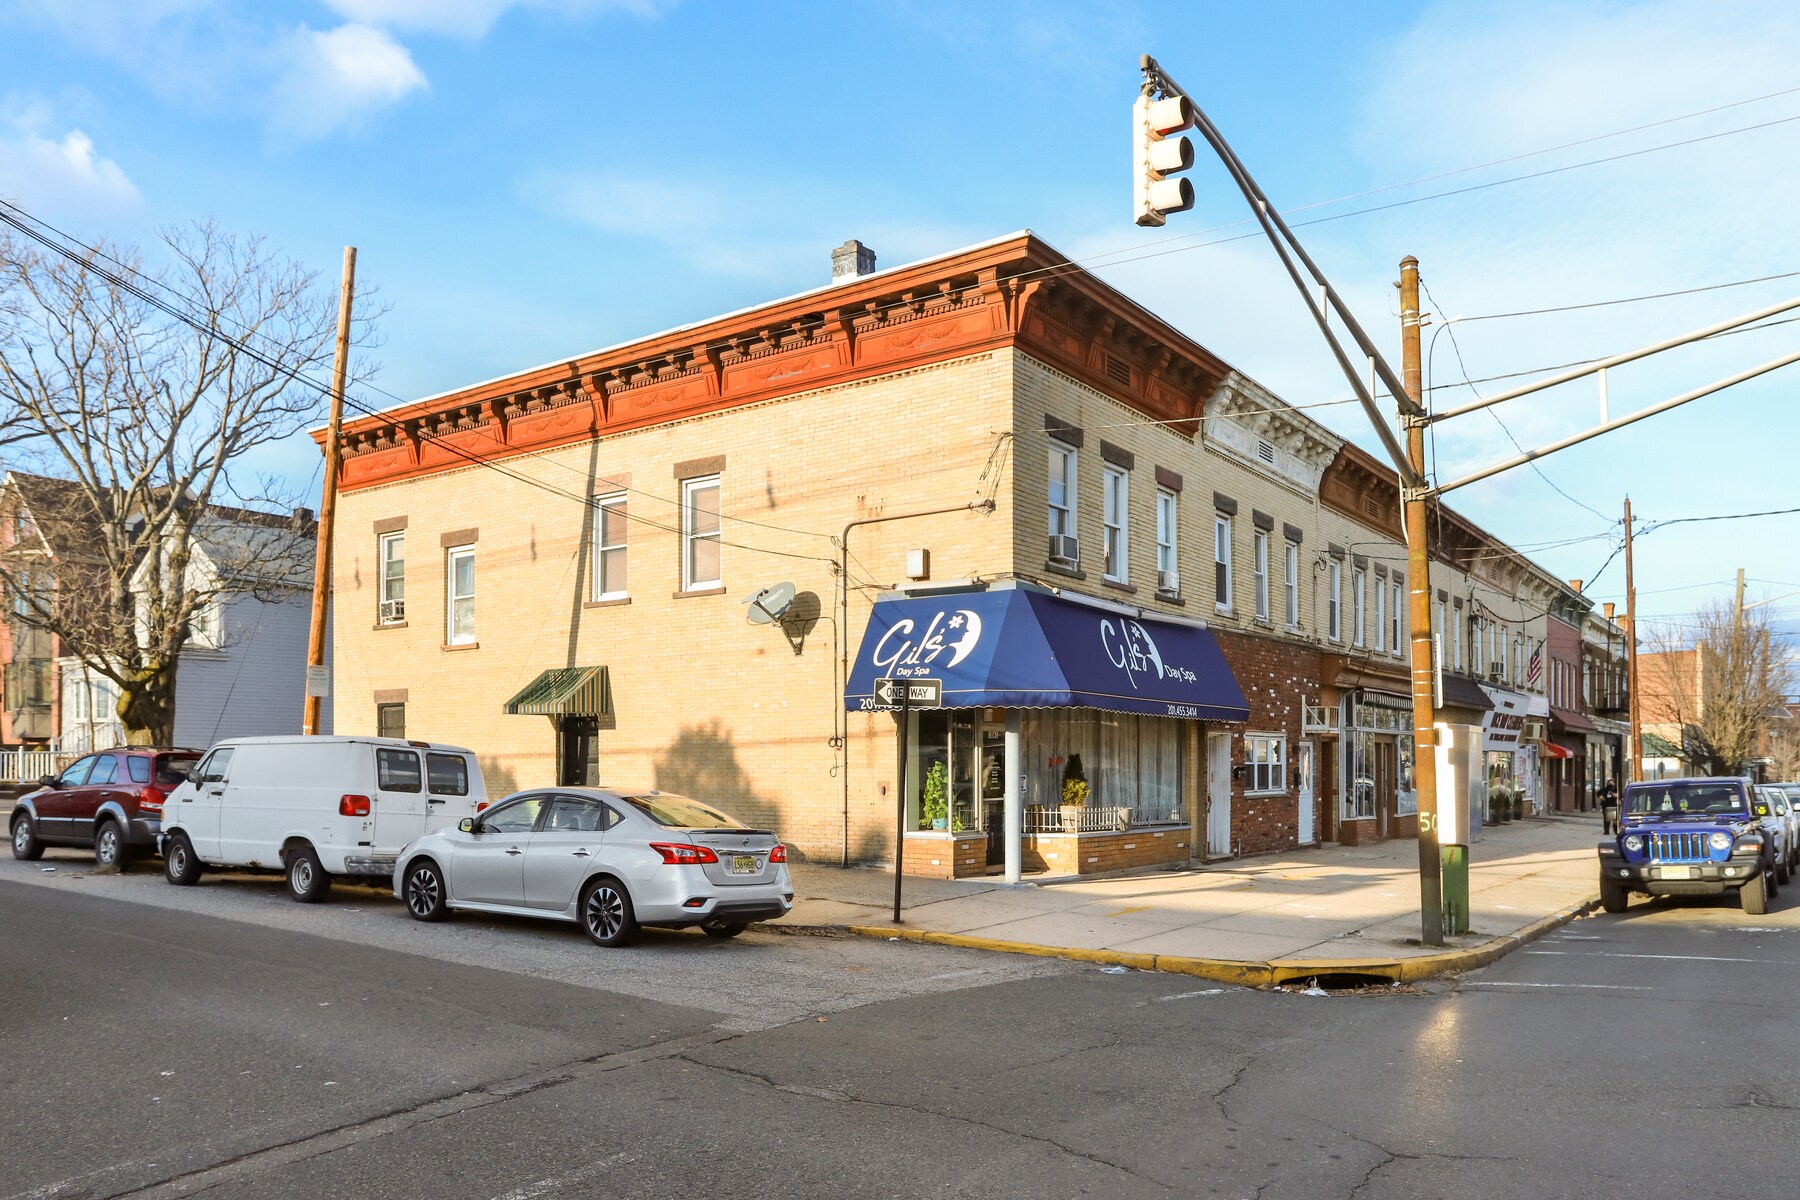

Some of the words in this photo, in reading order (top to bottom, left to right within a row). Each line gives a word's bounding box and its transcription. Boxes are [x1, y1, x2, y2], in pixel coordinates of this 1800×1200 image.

[873, 611, 946, 679] Gil's
[896, 667, 913, 678] Day
[914, 666, 930, 677] Spa
[1164, 664, 1183, 682] Day
[1180, 667, 1197, 683] Spa
[886, 687, 904, 698] ONE
[910, 687, 928, 698] WAY
[1167, 704, 1198, 717] 201.455.3414
